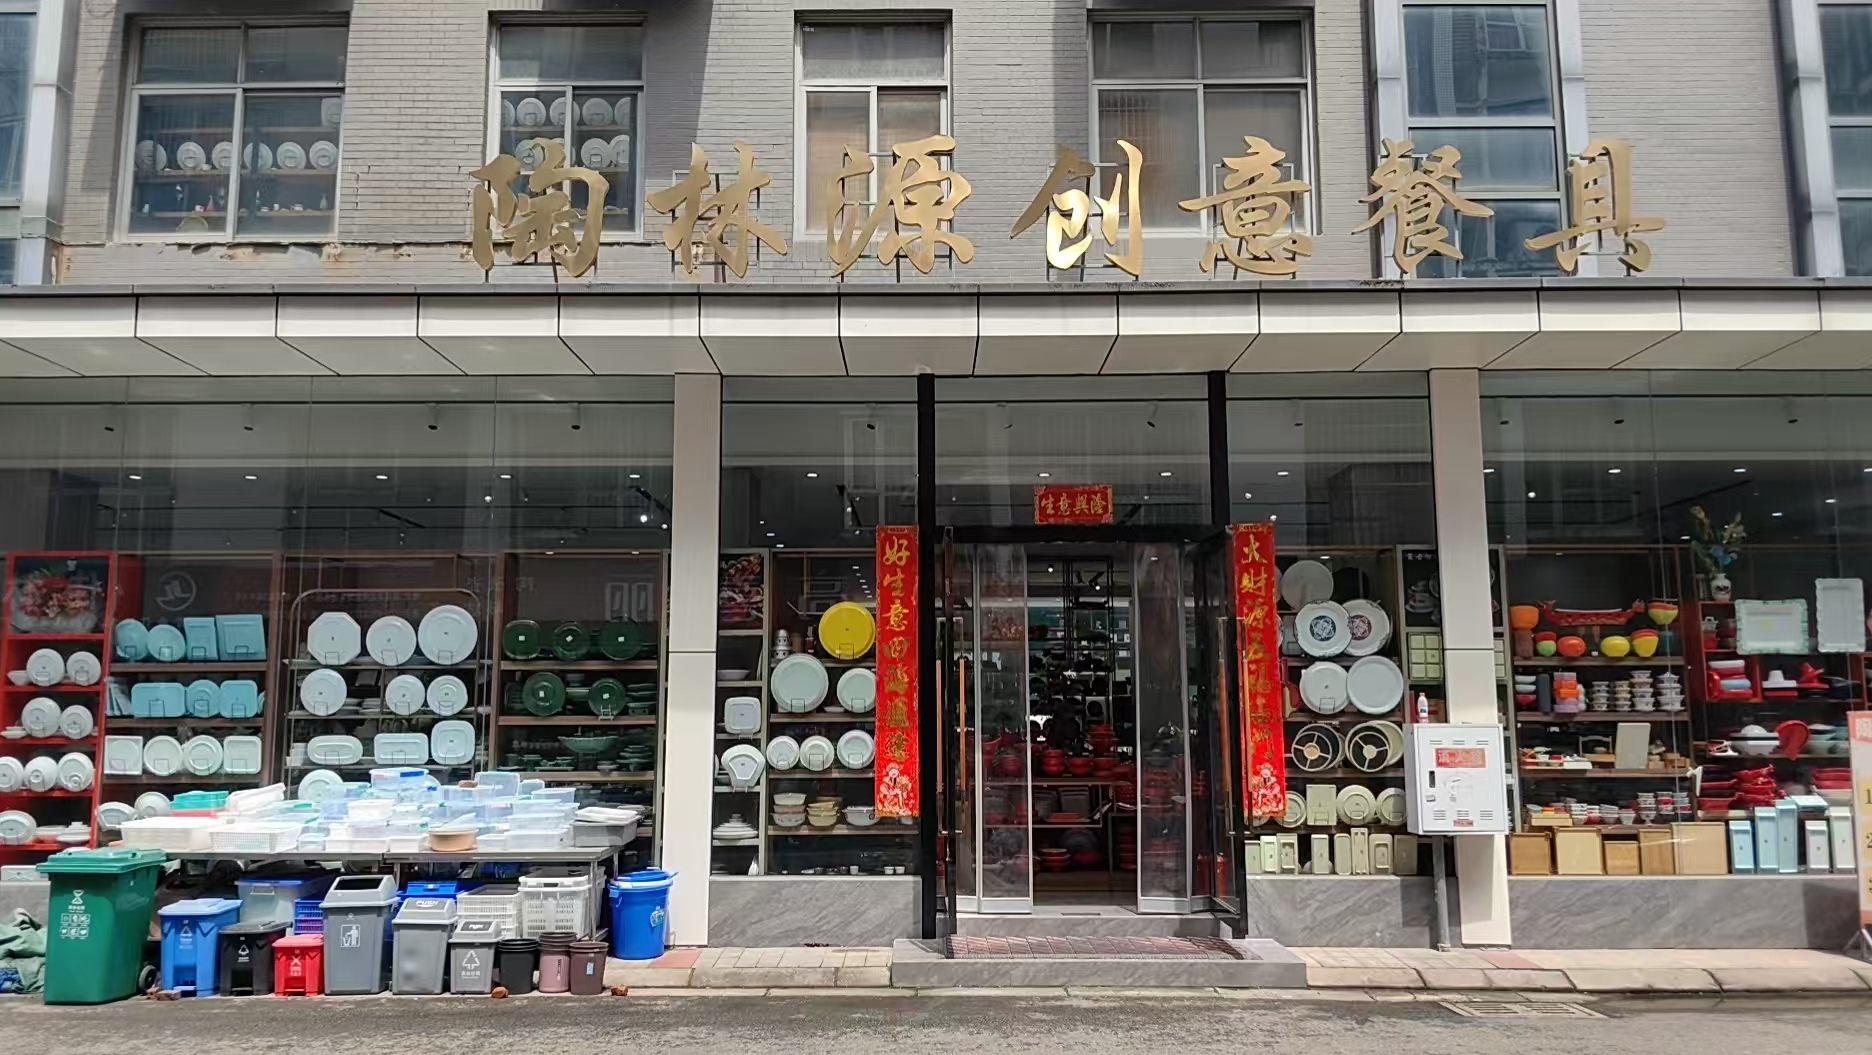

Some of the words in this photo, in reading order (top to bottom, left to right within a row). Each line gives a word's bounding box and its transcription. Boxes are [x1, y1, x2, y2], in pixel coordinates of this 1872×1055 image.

[470, 134, 1665, 277] 陶林源创意餐具
